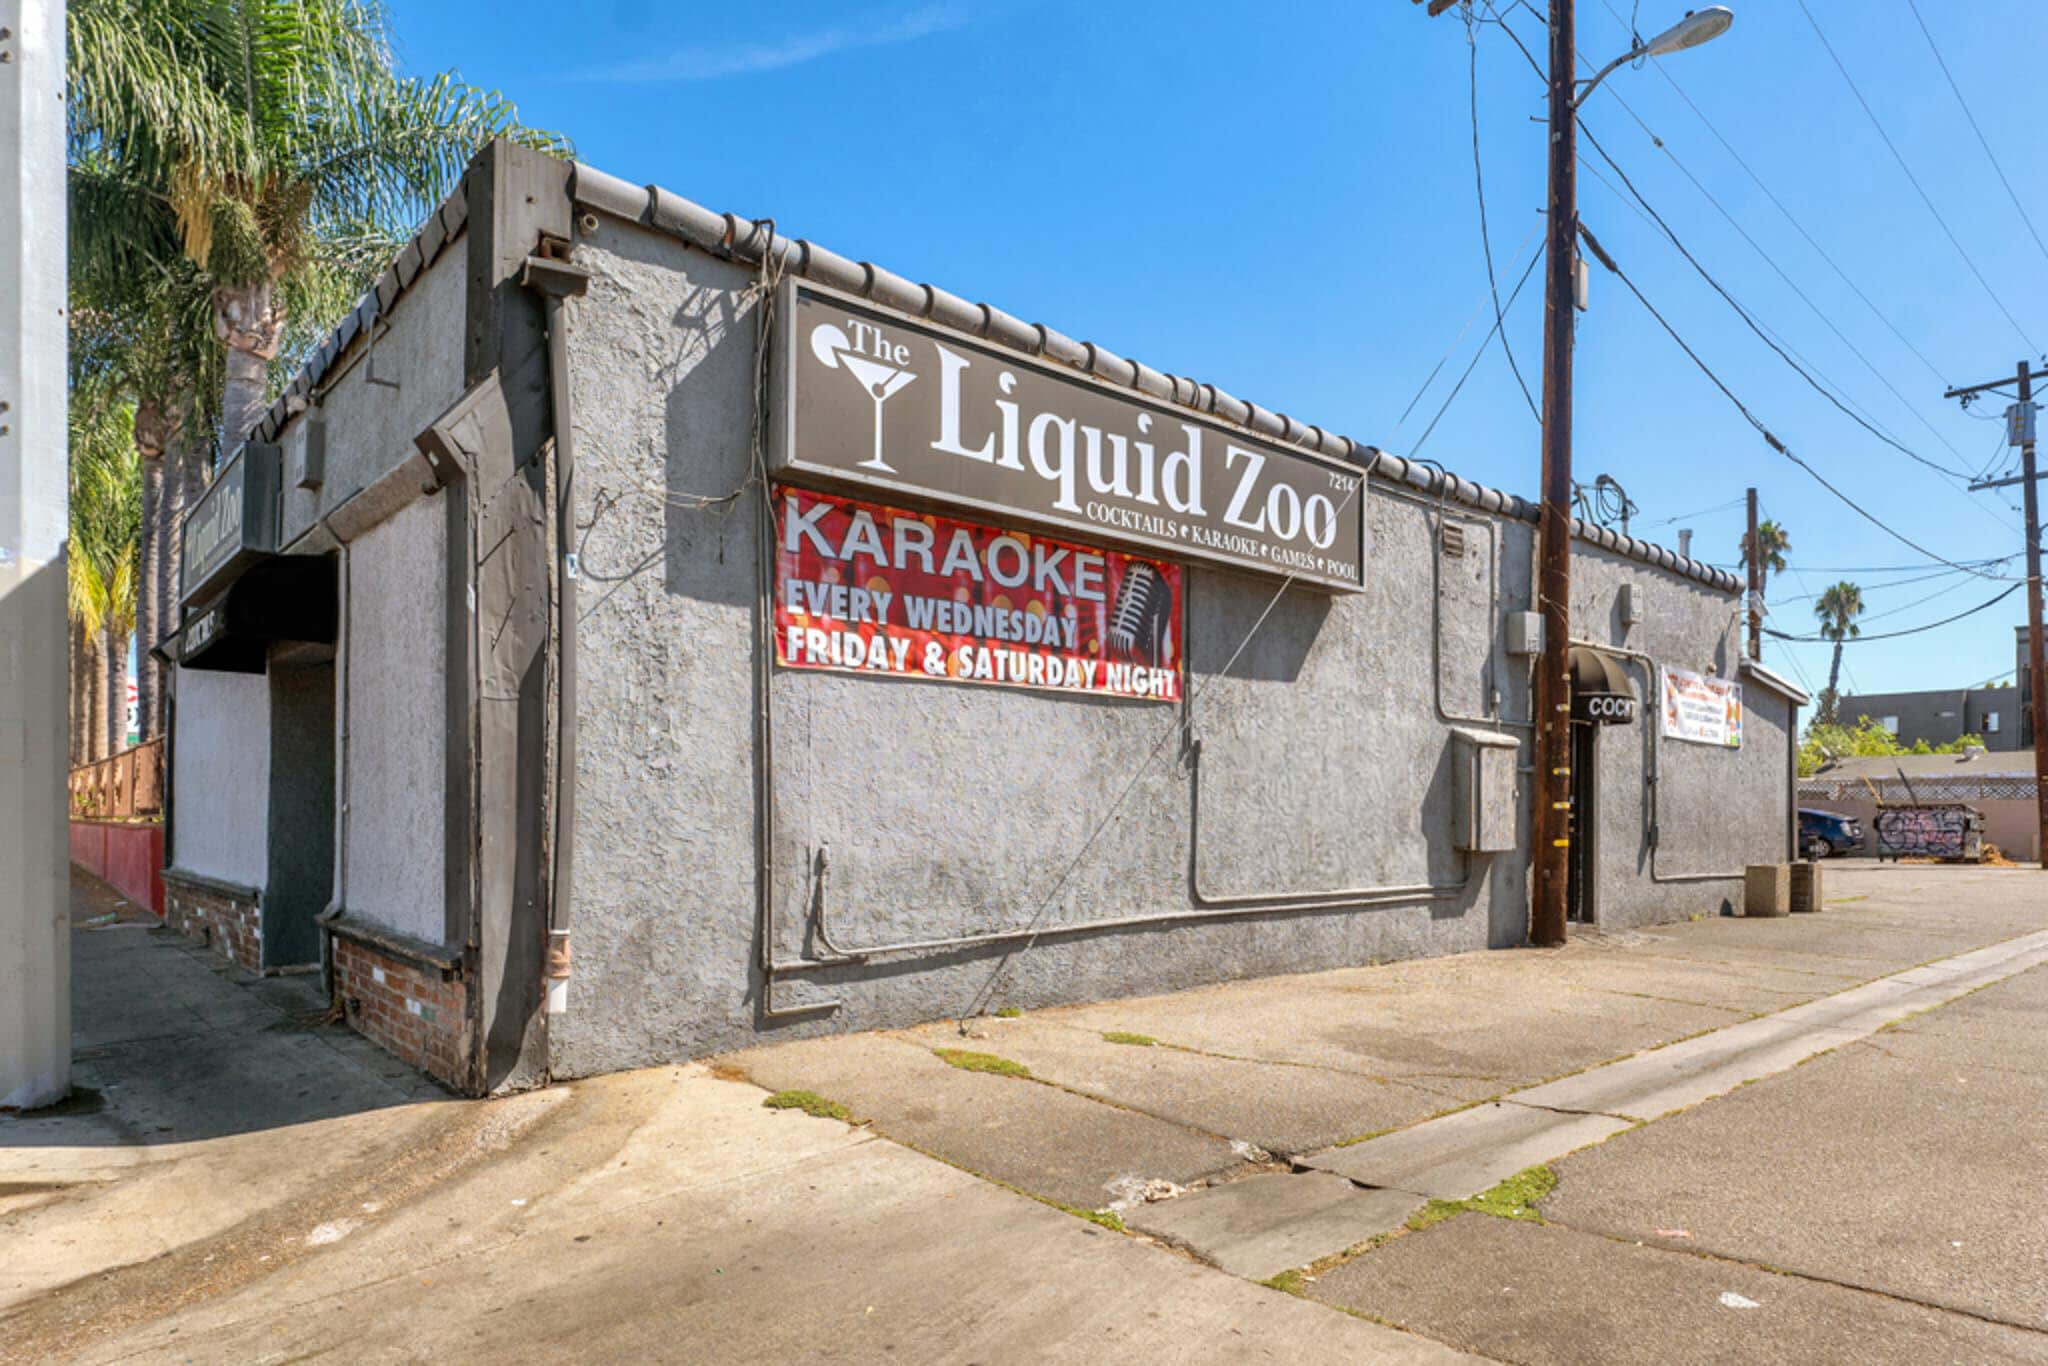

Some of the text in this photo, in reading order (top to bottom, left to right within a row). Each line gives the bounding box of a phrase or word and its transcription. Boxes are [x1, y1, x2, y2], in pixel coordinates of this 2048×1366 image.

[847, 320, 910, 366] The
[931, 342, 1338, 550] Liquid Zoo
[1328, 471, 1355, 493] 7214
[784, 495, 1106, 602] KARAOKE
[1087, 500, 1359, 582] COCKTAILS KARAOKE GAMES POOL
[785, 578, 1078, 650] EVERY WEDNESDAY
[786, 625, 1177, 698] FRIDAY & SATURDAY NIGHT
